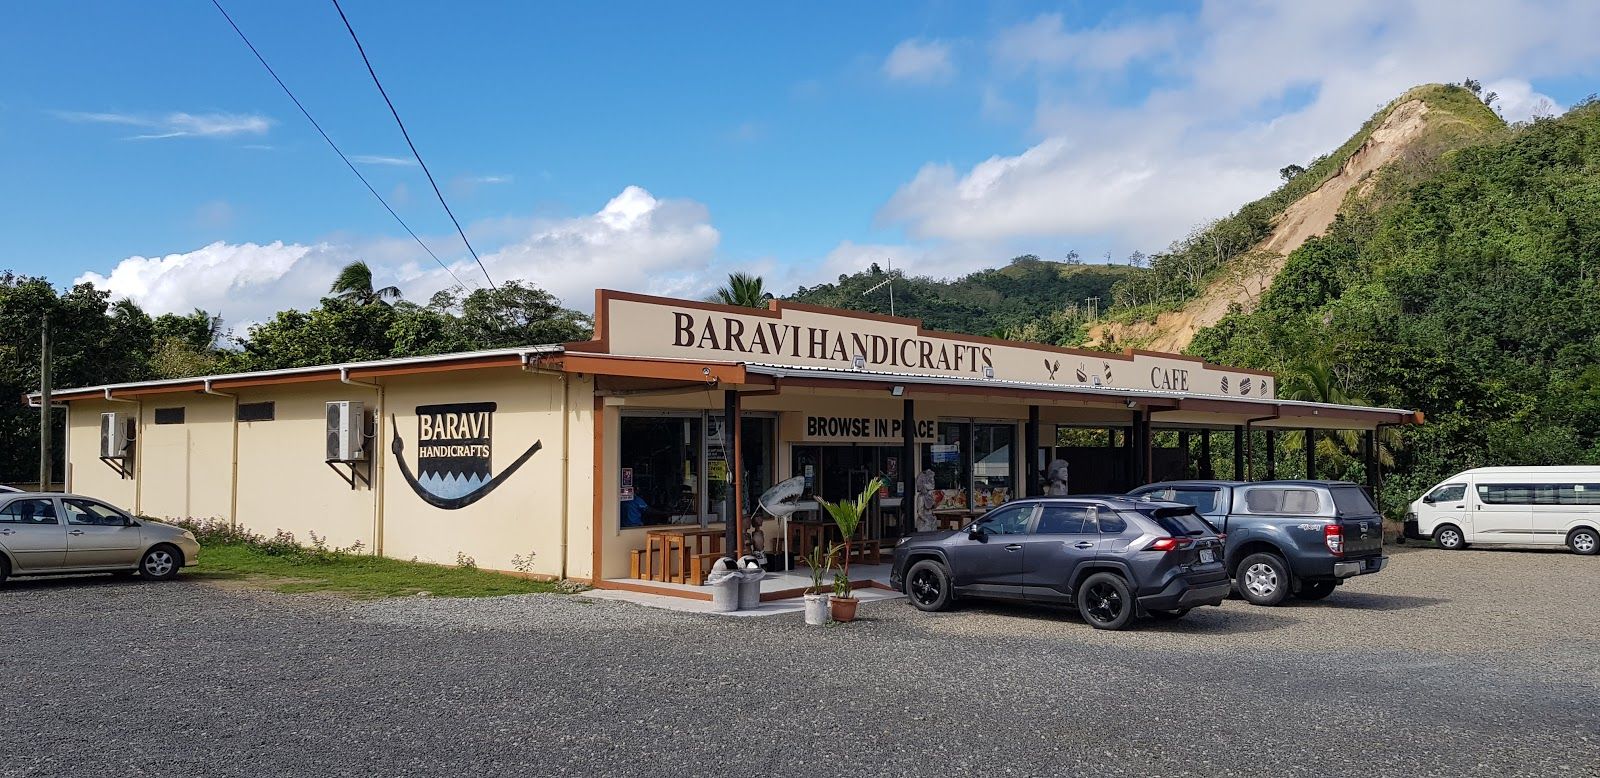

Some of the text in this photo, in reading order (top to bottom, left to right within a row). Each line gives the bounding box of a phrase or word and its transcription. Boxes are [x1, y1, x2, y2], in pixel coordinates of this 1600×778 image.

[672, 311, 993, 372] BARAVI HANDICRAFTS
[1150, 366, 1189, 391] CAFE
[420, 411, 490, 441] BARAVI
[807, 416, 870, 437] BROWSE
[875, 418, 888, 437] IN
[419, 444, 490, 458] HANDICRAFTS
